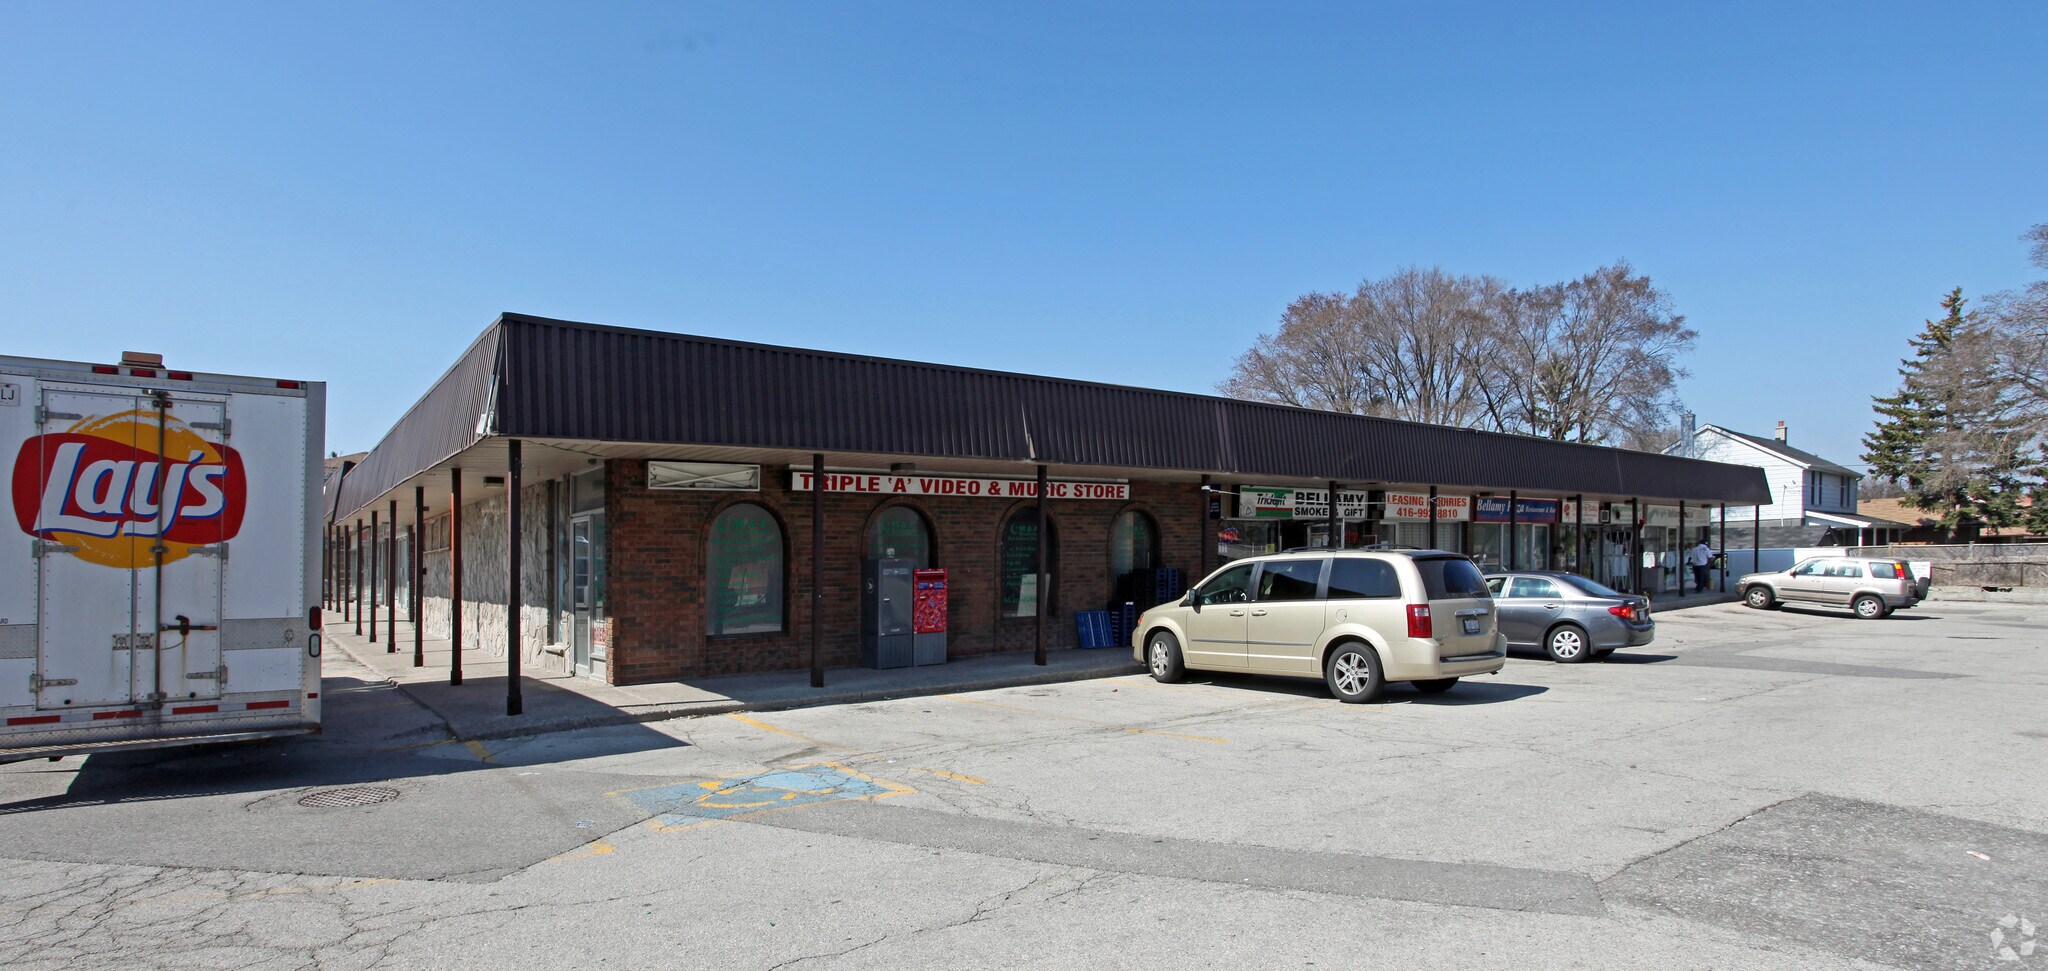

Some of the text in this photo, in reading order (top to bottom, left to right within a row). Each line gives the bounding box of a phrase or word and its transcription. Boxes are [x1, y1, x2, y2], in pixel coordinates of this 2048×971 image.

[33, 443, 228, 538] Lay's
[888, 478, 912, 493] 'A'
[919, 478, 981, 496] VIDEO
[987, 481, 1002, 496] &
[1073, 484, 1125, 499] STORE
[1256, 493, 1287, 506] Trident
[1387, 494, 1467, 508] LEASING IQUIRIES
[1294, 507, 1329, 517] SMOKE
[1344, 508, 1364, 518] GIFT
[1396, 507, 1458, 519] 416-998810
[1477, 499, 1506, 515] Bellamy
